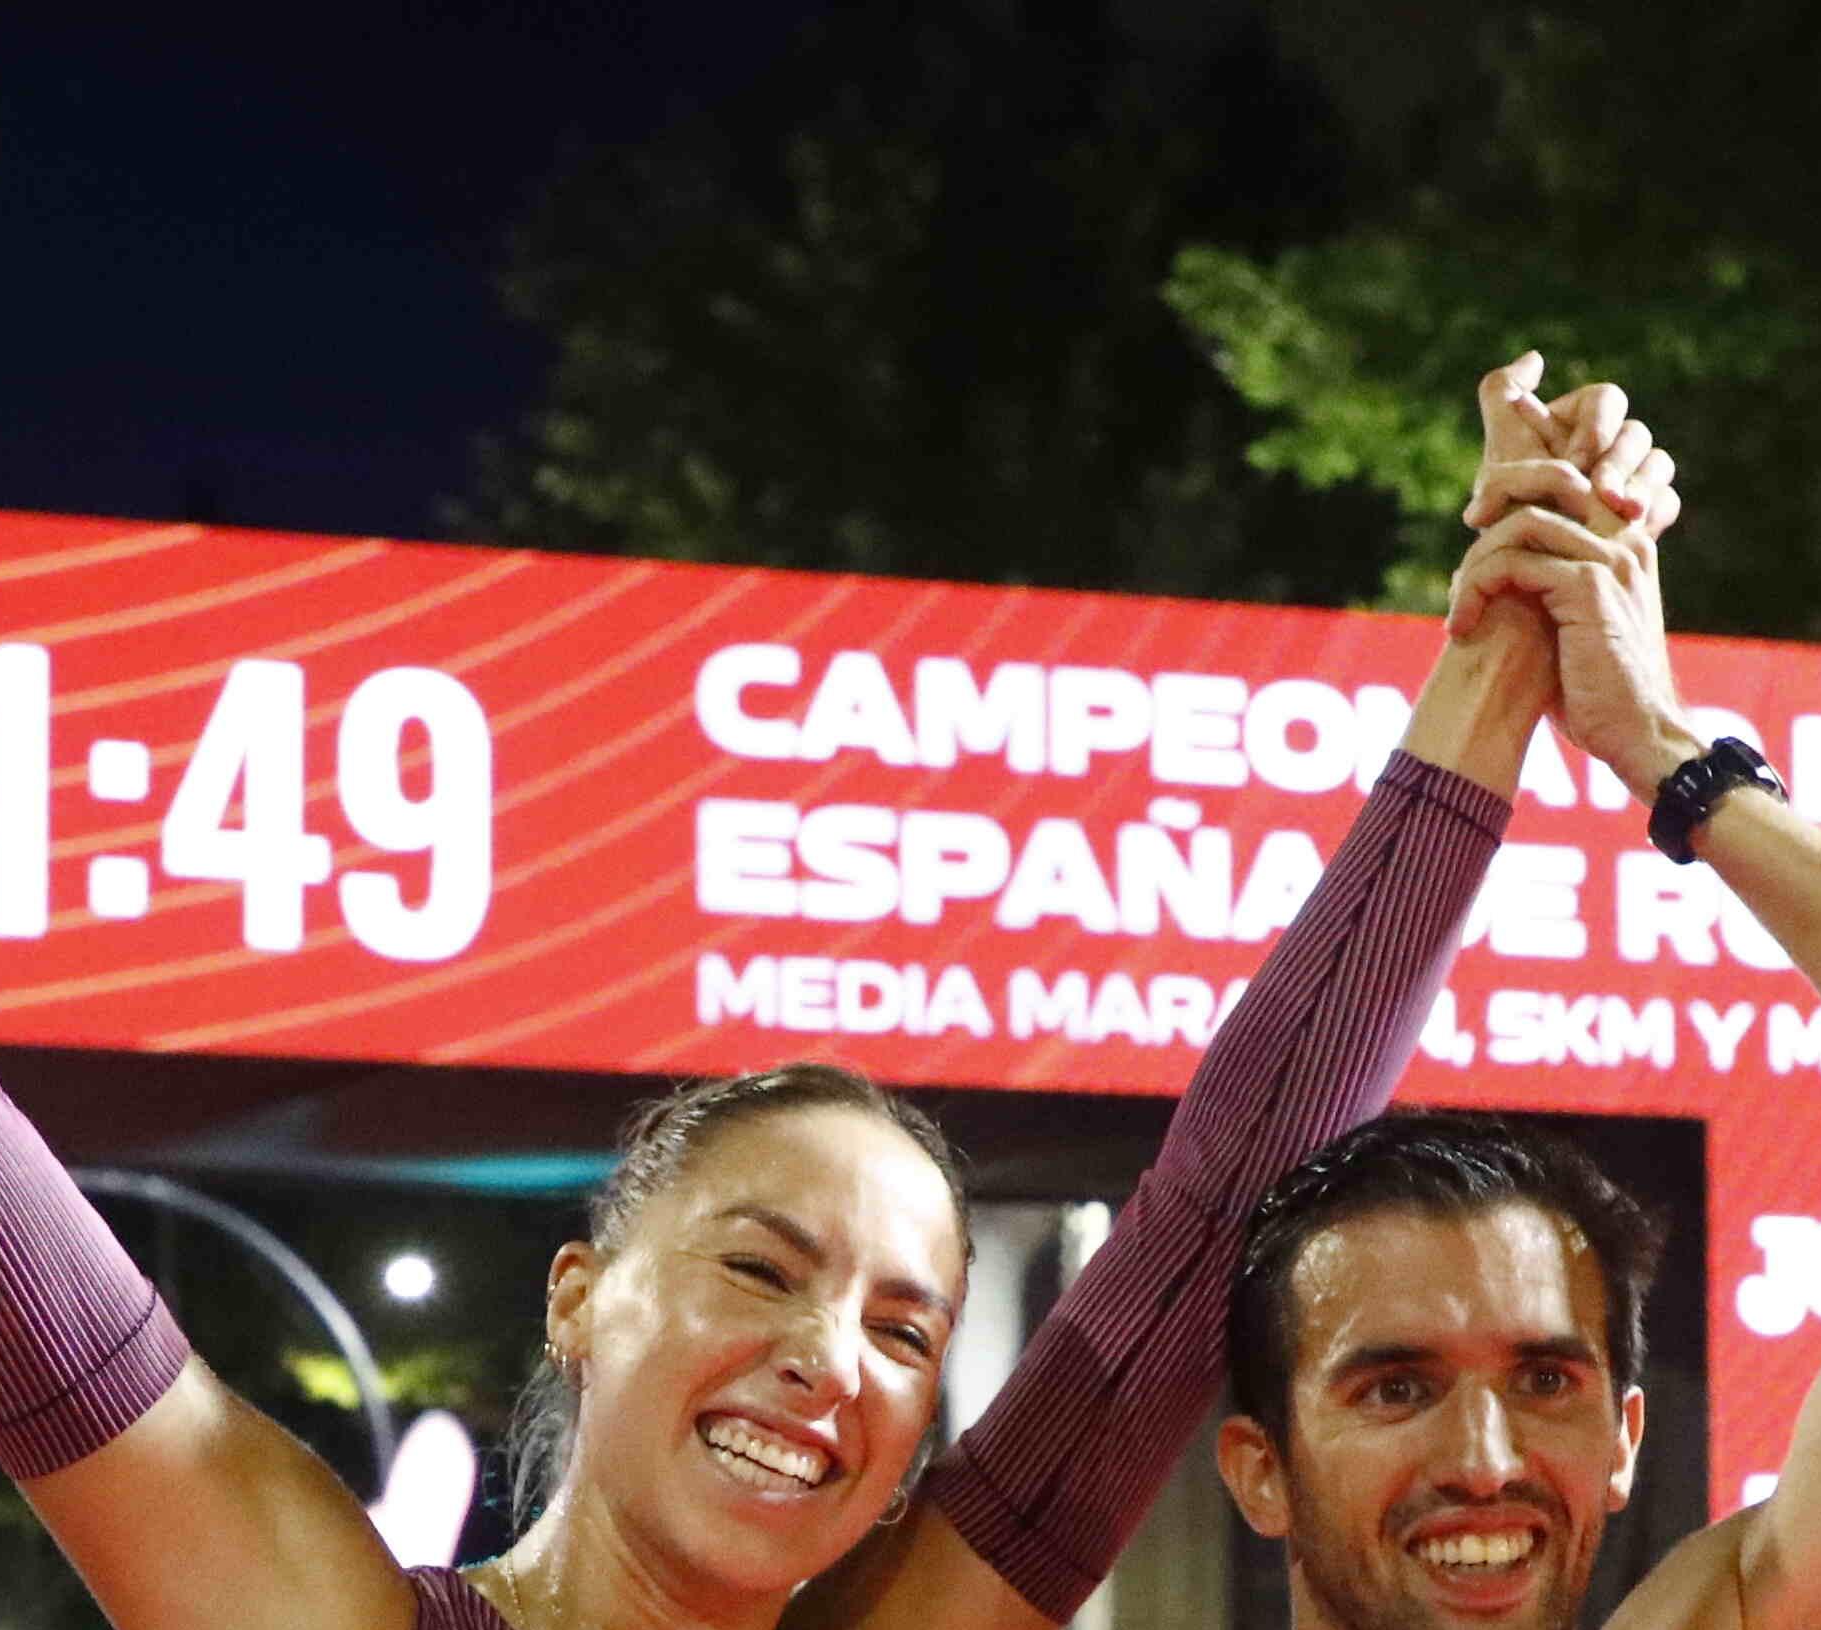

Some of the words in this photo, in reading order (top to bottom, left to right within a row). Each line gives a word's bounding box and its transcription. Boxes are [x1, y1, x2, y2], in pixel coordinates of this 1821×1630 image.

[695, 642, 1770, 812] CAMPEO
[695, 795, 1338, 943] ESPAÑA
[1461, 840, 1590, 960] E
[695, 951, 995, 1037] MEDIA
[1485, 988, 1676, 1070] 5KM
[1686, 999, 1757, 1073] Y
